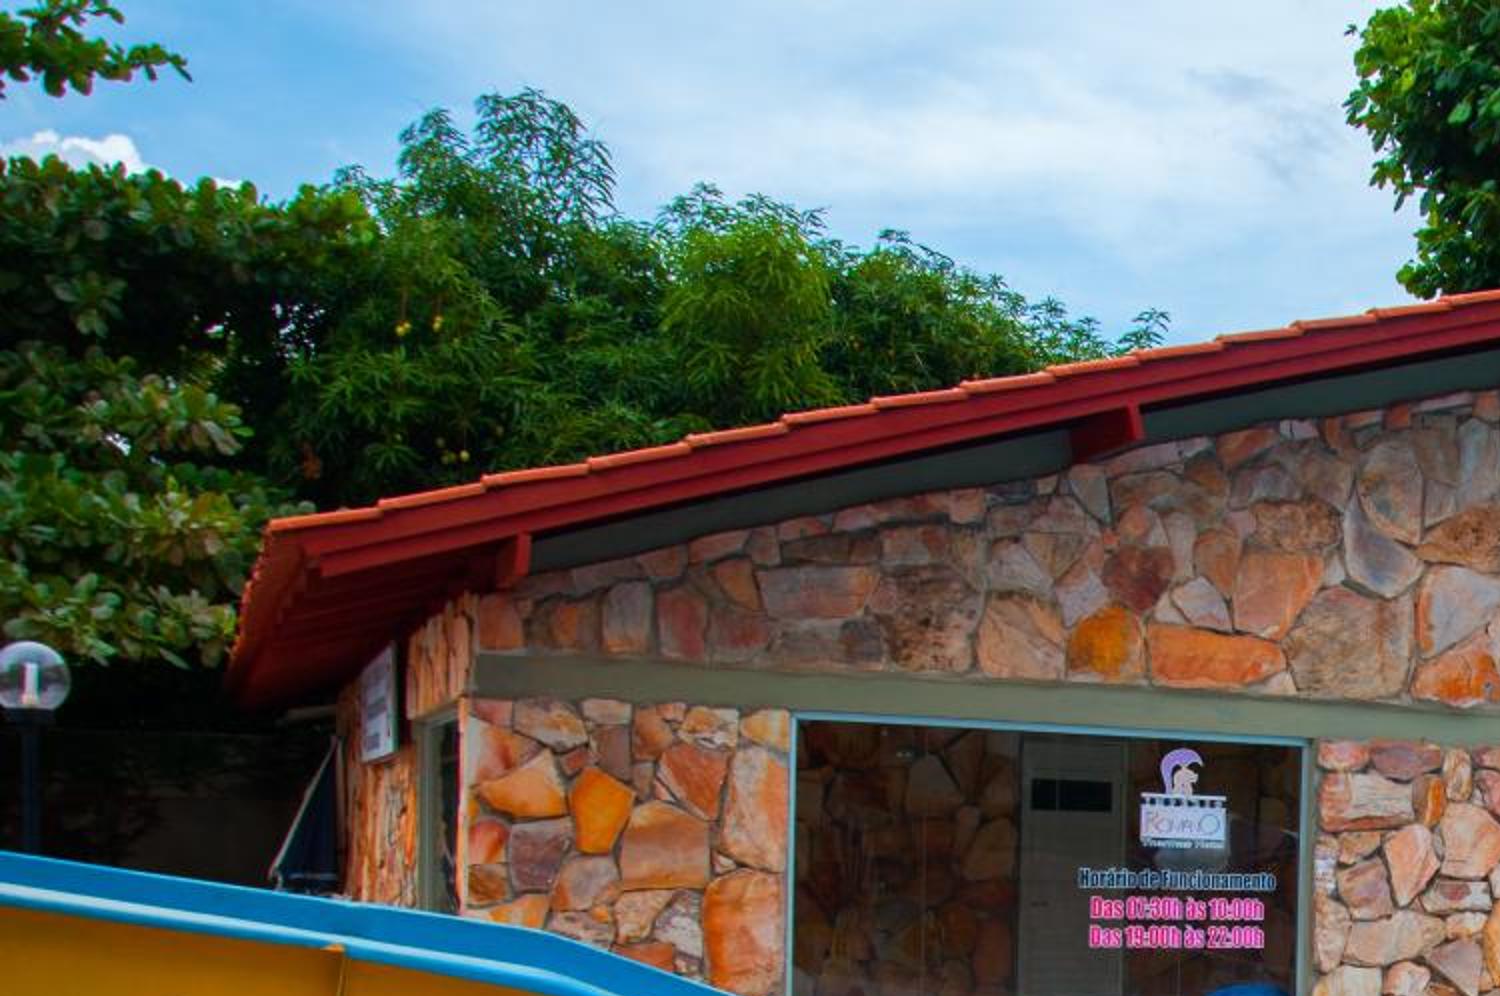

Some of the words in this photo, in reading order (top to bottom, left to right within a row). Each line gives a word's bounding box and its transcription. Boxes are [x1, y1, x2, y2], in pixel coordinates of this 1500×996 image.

[1078, 867, 1137, 889] Horário
[1139, 868, 1160, 889] de
[1162, 869, 1277, 892] Funcionamento
[1090, 896, 1124, 919] Das
[1185, 897, 1206, 921] às
[1089, 924, 1122, 948] Das
[1125, 924, 1182, 949] 19:00h
[1184, 924, 1205, 949] às
[1207, 926, 1265, 949] 22:00h
